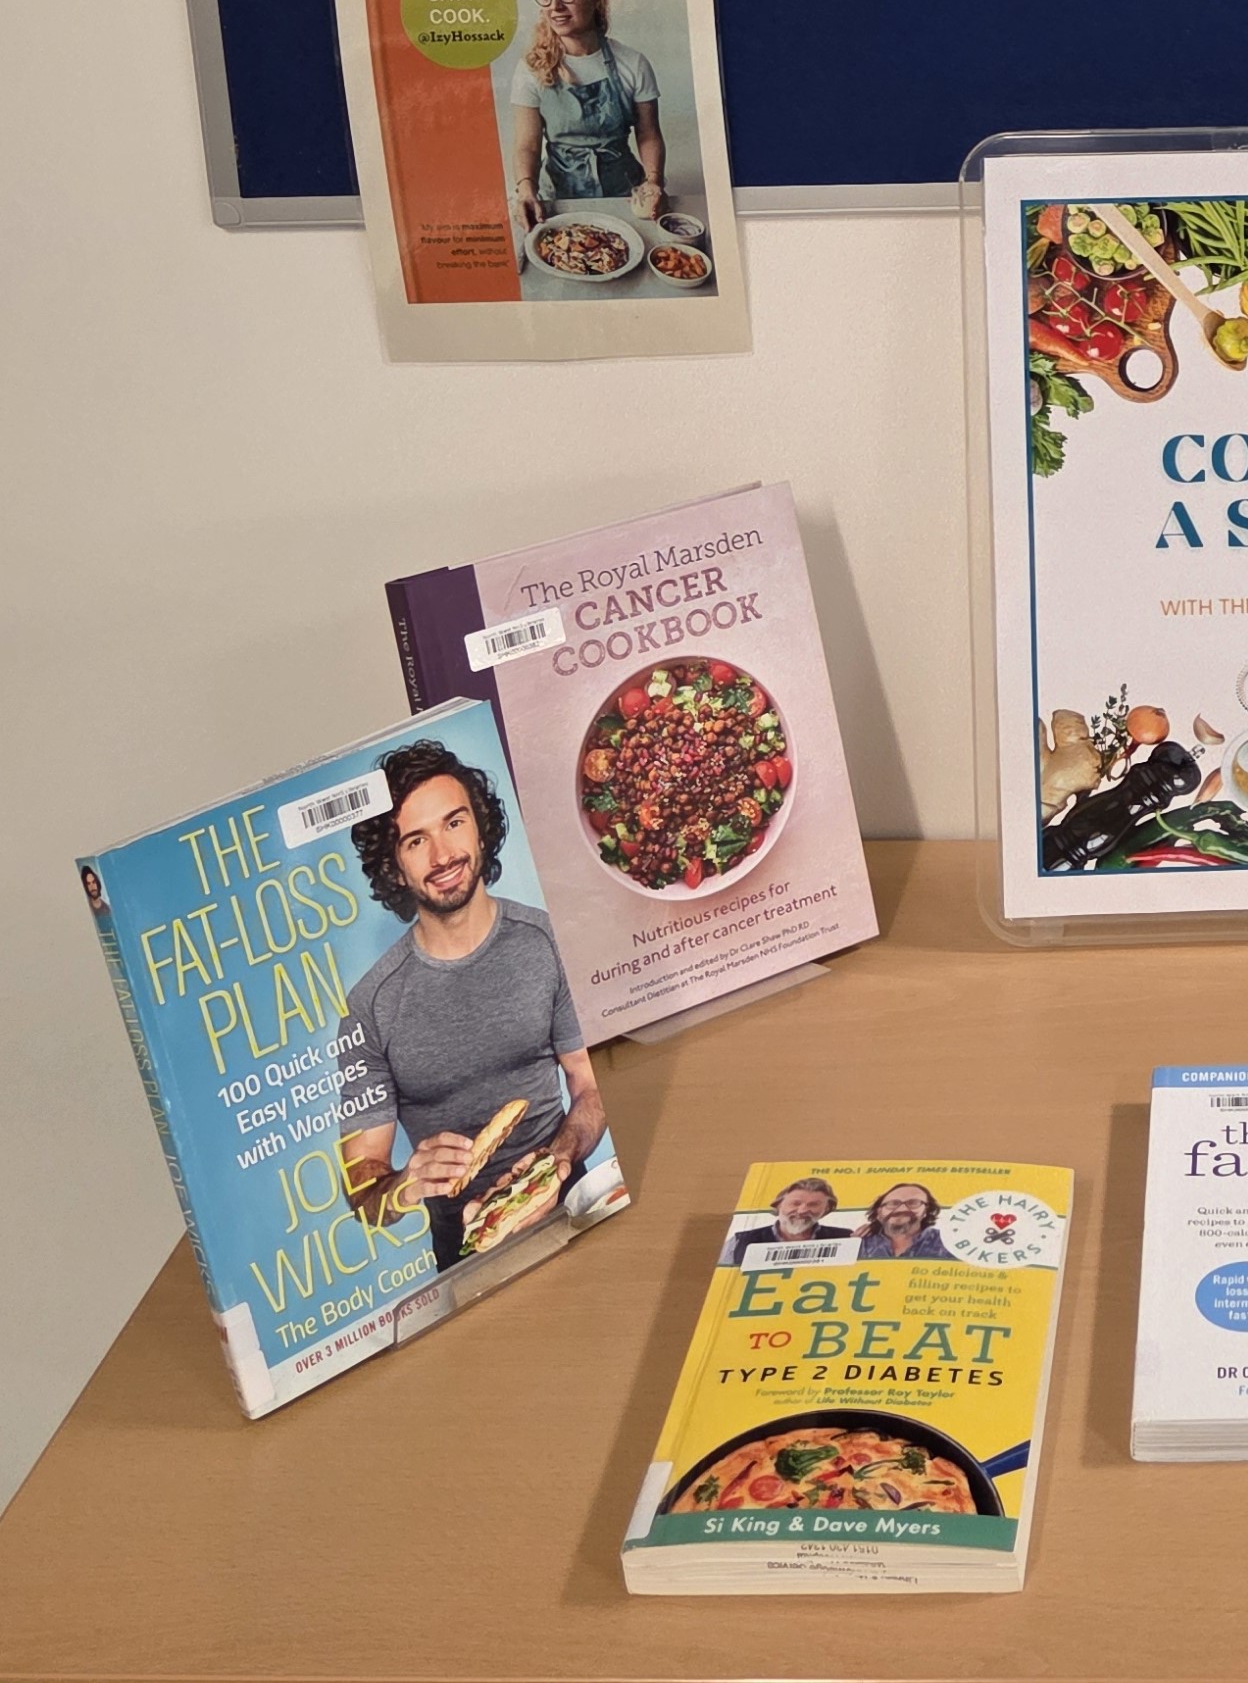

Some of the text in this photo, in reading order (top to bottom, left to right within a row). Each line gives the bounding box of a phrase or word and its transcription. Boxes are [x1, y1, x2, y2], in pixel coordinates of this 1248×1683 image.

[418, 30, 505, 45] @IzyHossack
[430, 8, 491, 25] COOK.
[1155, 501, 1204, 550] A
[521, 527, 763, 608] The Royal Marsden
[573, 567, 727, 632] CANCER
[551, 593, 763, 677] COOKBOOK
[1160, 599, 1213, 616] WITH
[179, 805, 281, 895] THE
[141, 851, 358, 1006] FAT-LOSS
[632, 881, 790, 947] Nutritious recipes for
[199, 943, 351, 1075] PLAN
[217, 1024, 366, 1109] 100 Quick and
[236, 1059, 369, 1135] Easy Recipes
[236, 1083, 388, 1170] with Workouts
[277, 1130, 378, 1234] JOE
[250, 1180, 432, 1315] WICKS
[275, 1249, 438, 1350] The Body Coach
[729, 1268, 880, 1318] Eat
[718, 1365, 1004, 1386] TYPE 2 DIABETES
[749, 1321, 1011, 1364] TO BEAT
[704, 1516, 941, 1539] Si King & Dave Myers
